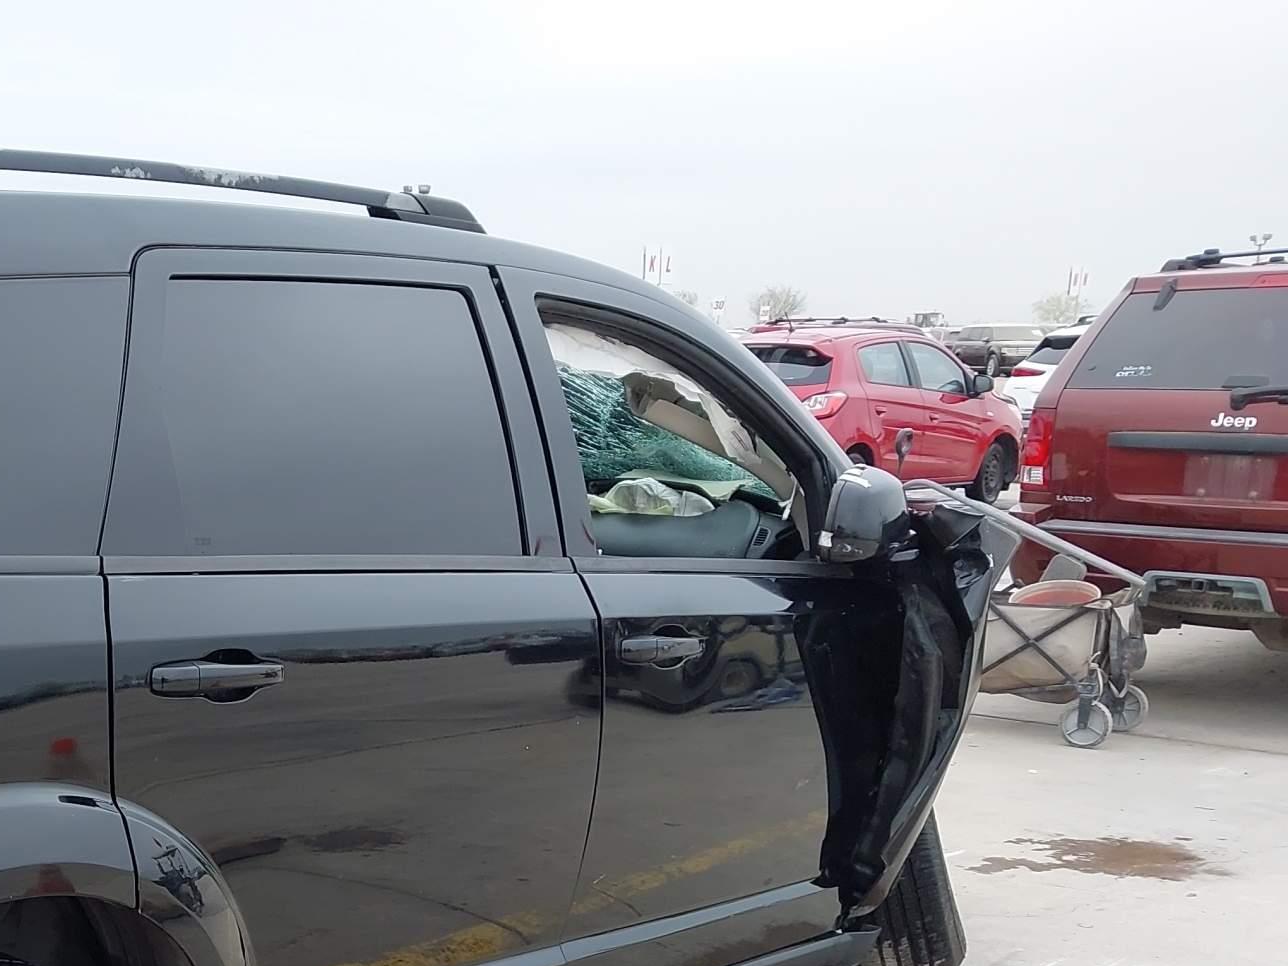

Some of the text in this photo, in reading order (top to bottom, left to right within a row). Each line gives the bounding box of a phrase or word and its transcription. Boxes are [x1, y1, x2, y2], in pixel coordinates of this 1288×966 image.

[665, 255, 672, 273] L
[713, 300, 725, 310] 30
[1210, 412, 1259, 430] Jeep
